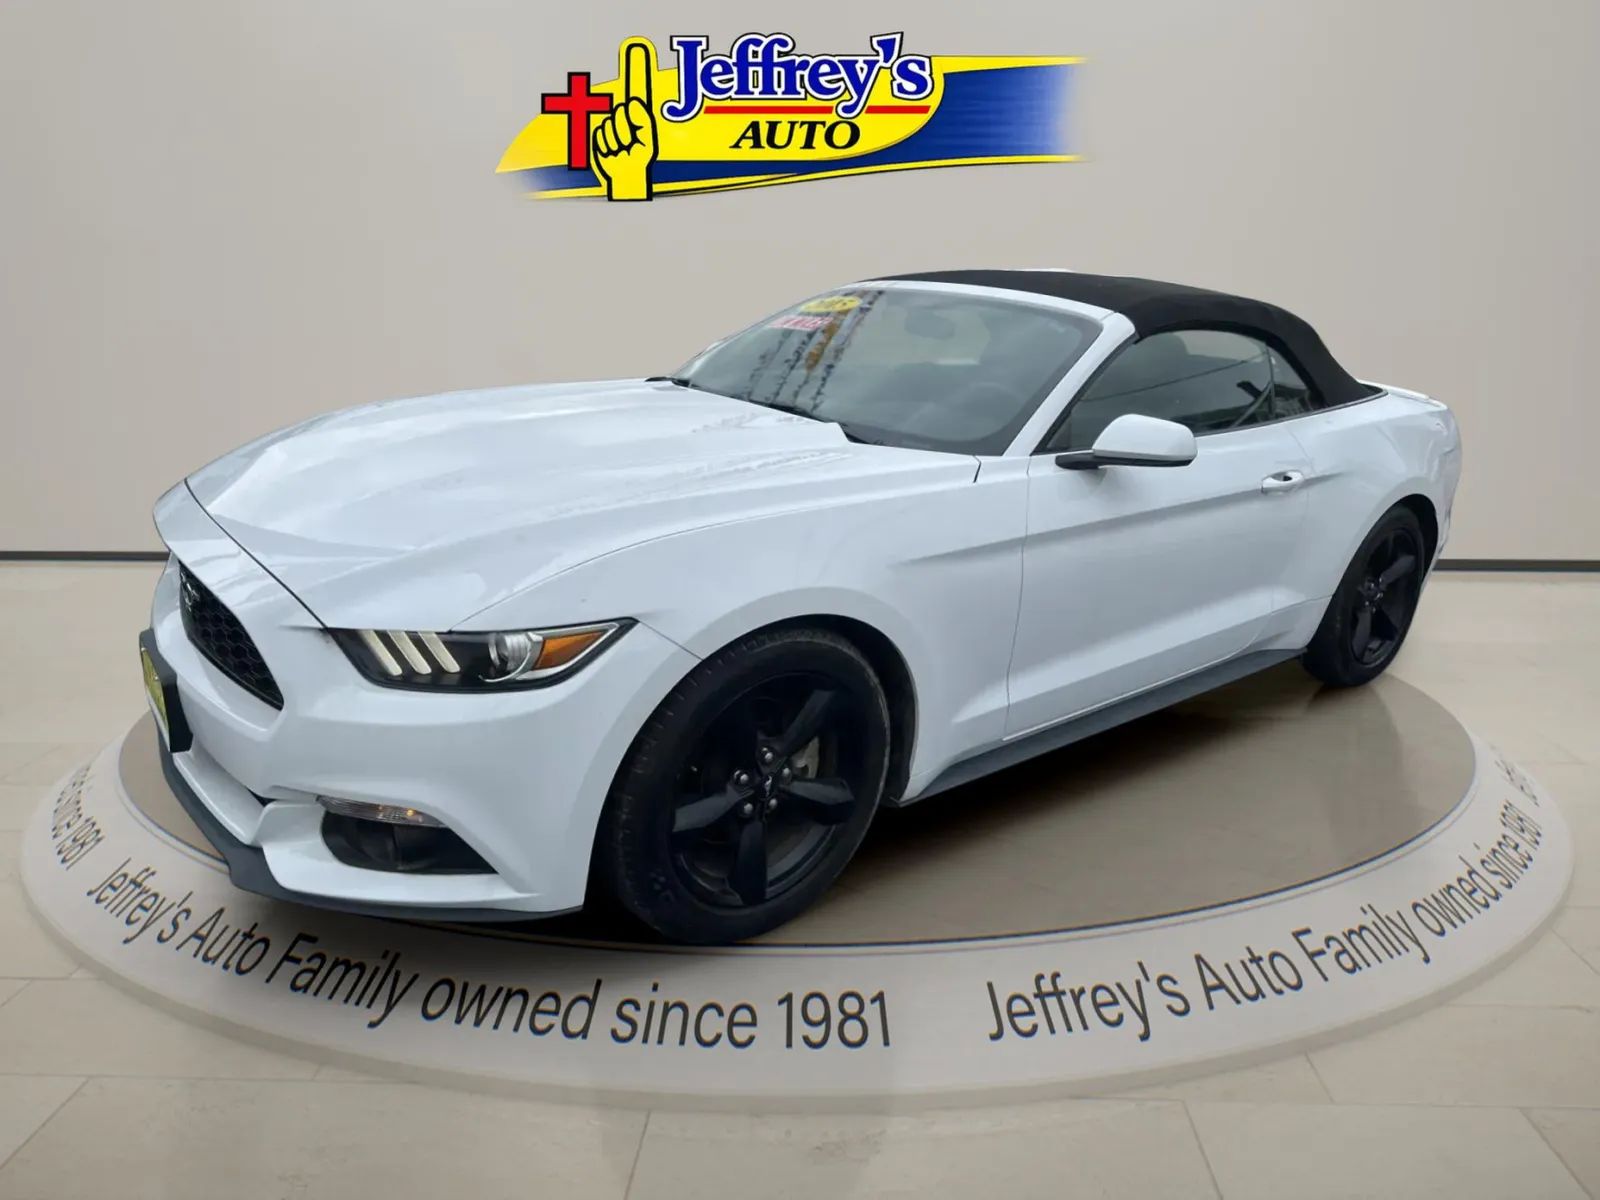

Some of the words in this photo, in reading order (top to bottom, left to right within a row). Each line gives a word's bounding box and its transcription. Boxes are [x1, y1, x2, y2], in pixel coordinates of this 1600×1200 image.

[662, 31, 935, 119] Jeffrey's
[729, 120, 861, 150] AUTO
[56, 815, 105, 871] 1981
[1473, 833, 1533, 890] since
[1499, 800, 1542, 851] 1981
[1411, 854, 1502, 937] owned
[86, 857, 193, 944] Jeffrey's
[176, 906, 271, 976] Auto
[264, 932, 419, 1029] Family
[421, 976, 602, 1040] owned
[610, 982, 758, 1049] since
[777, 989, 890, 1049] 1981
[1194, 945, 1303, 1011] Auto
[1291, 903, 1430, 982] Family
[988, 960, 1191, 1042] Jeffrey's
